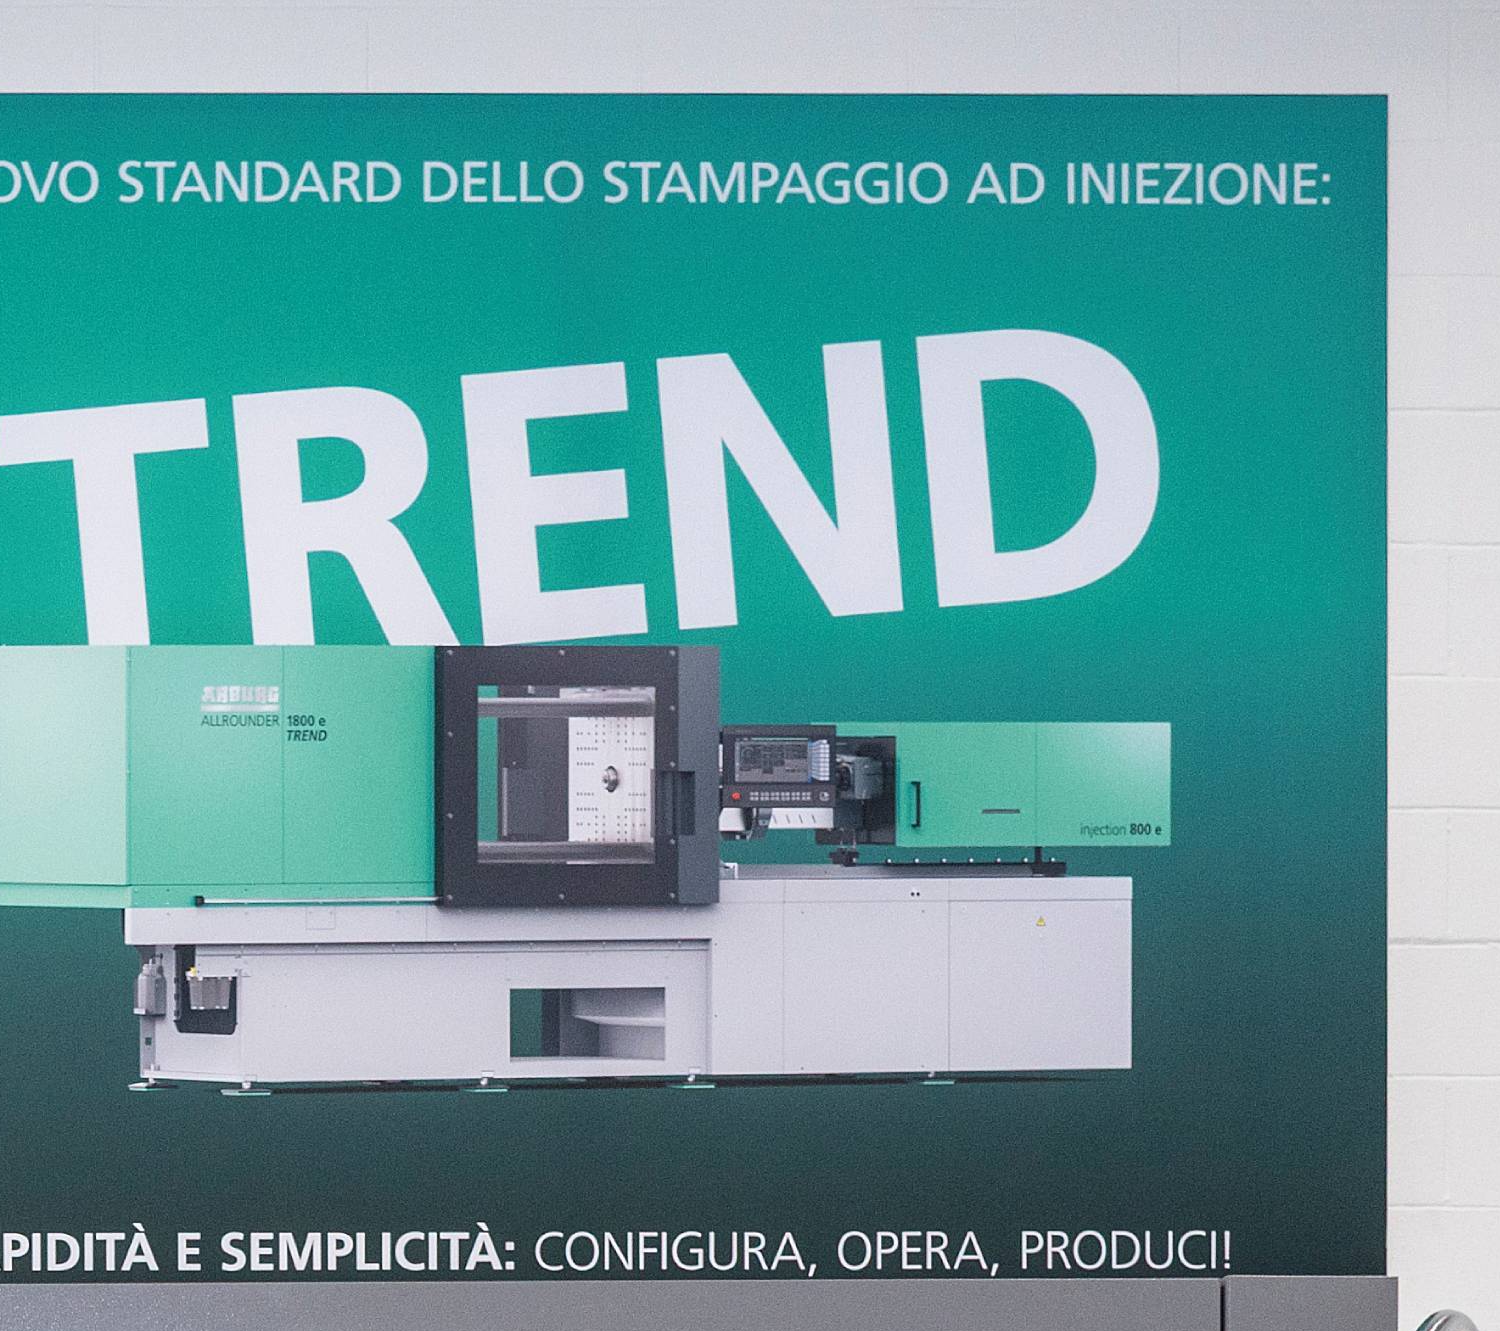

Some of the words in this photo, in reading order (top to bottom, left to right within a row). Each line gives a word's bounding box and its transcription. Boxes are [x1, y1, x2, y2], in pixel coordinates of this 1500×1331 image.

[119, 160, 401, 203] STANDARD
[423, 161, 584, 203] DELLO
[604, 161, 948, 204] STAMPAGGIO
[967, 163, 1045, 204] AD
[1067, 163, 1330, 205] INIEZIONE:
[201, 714, 280, 727] ALLROUNDER
[287, 714, 315, 727] 1800
[318, 716, 327, 727] e
[286, 729, 327, 741] TREND
[1080, 824, 1126, 838] injection
[1129, 823, 1152, 836] 800
[1155, 825, 1162, 835] e
[178, 1233, 201, 1270] E
[221, 1222, 514, 1271] SEMPLICITÀ:
[535, 1231, 816, 1277] CONFIGURA,
[838, 1231, 998, 1276] OPERA,
[1022, 1230, 1233, 1271] PRODUCI!
